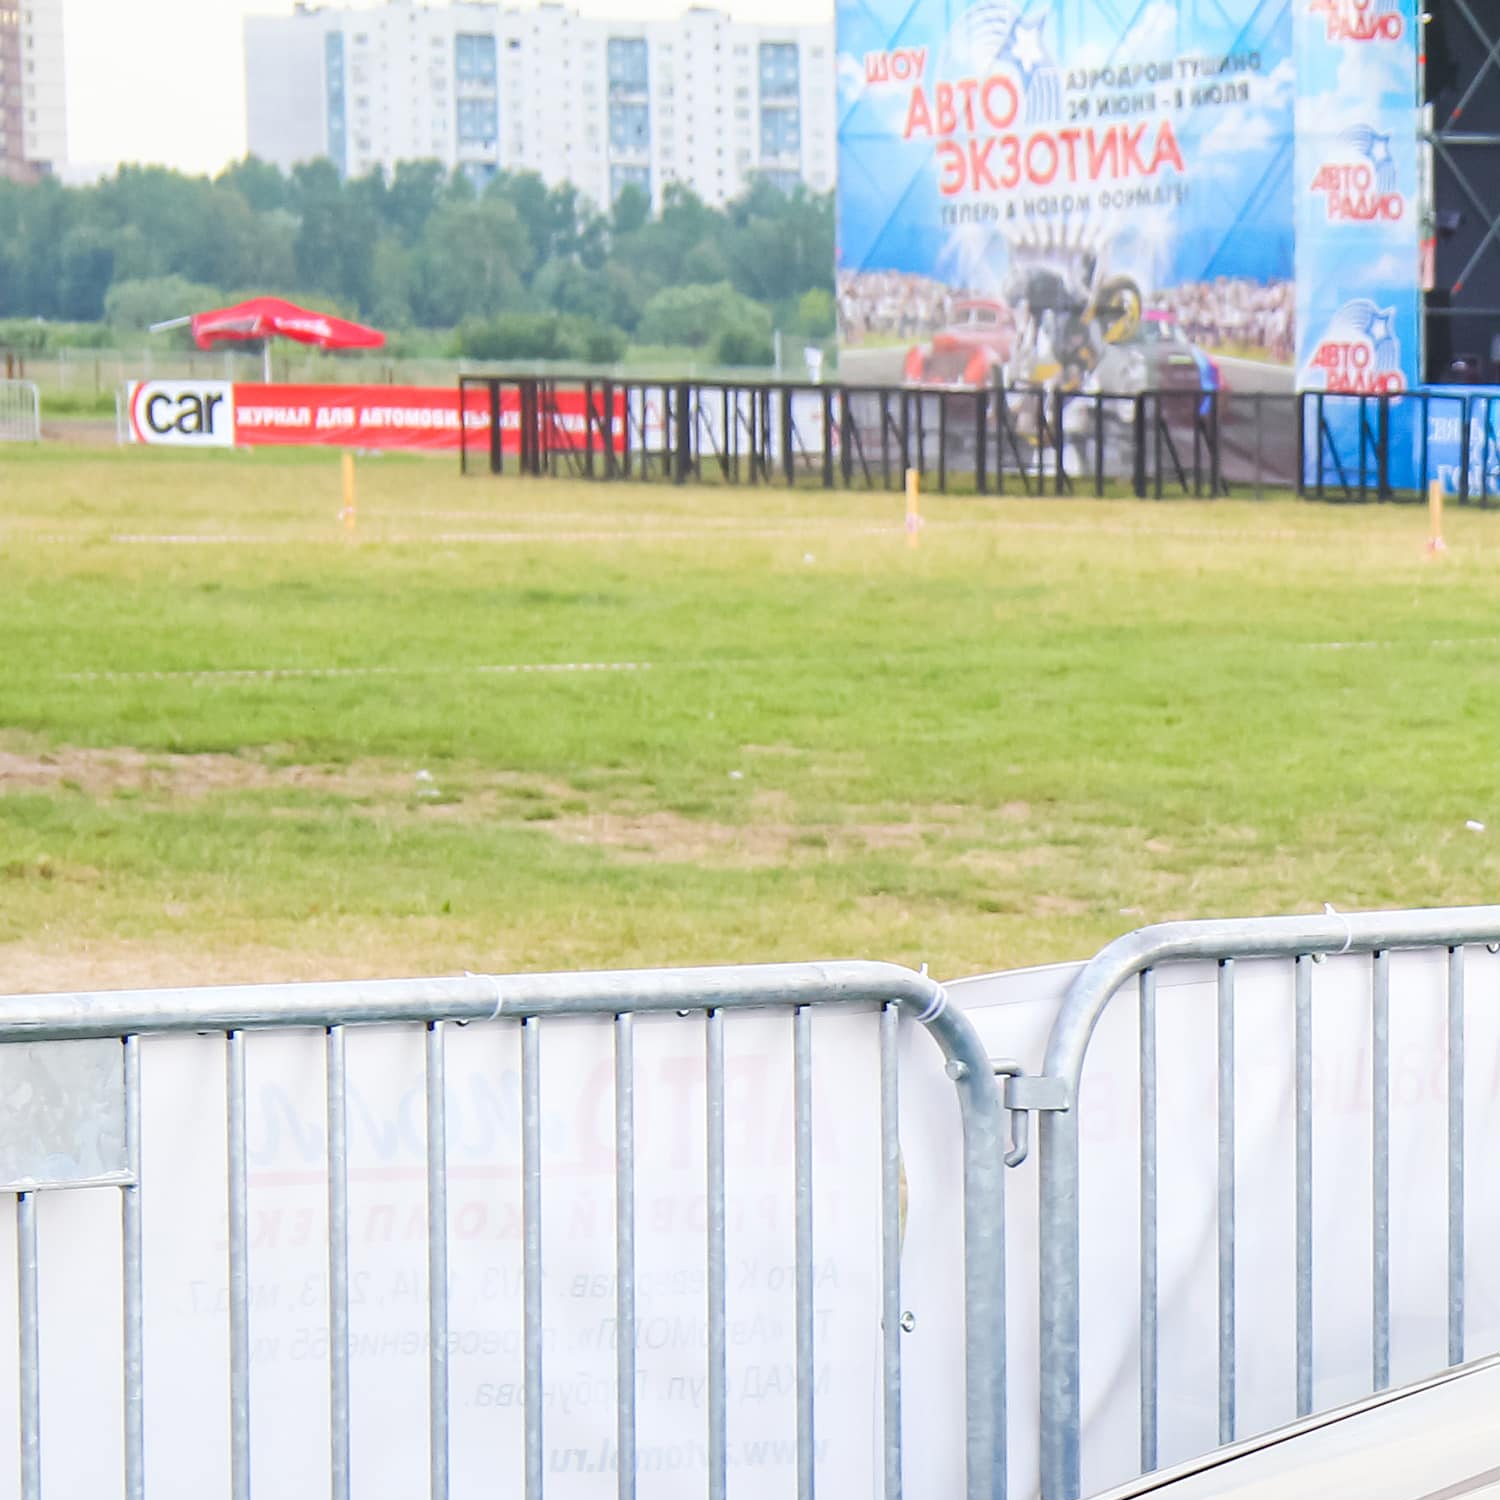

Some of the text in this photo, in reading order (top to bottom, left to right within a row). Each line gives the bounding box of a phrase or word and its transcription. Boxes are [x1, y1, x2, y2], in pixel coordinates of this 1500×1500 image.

[865, 48, 927, 84] ШОУ
[904, 75, 1019, 139] АВТО
[936, 119, 1186, 197] ЭКЗОТИКА
[1311, 163, 1372, 192] АВТО
[1328, 184, 1404, 220] РАДИО
[1309, 341, 1370, 370] АВТО
[145, 390, 223, 434] car
[237, 407, 310, 427] ЖУРНАЛ
